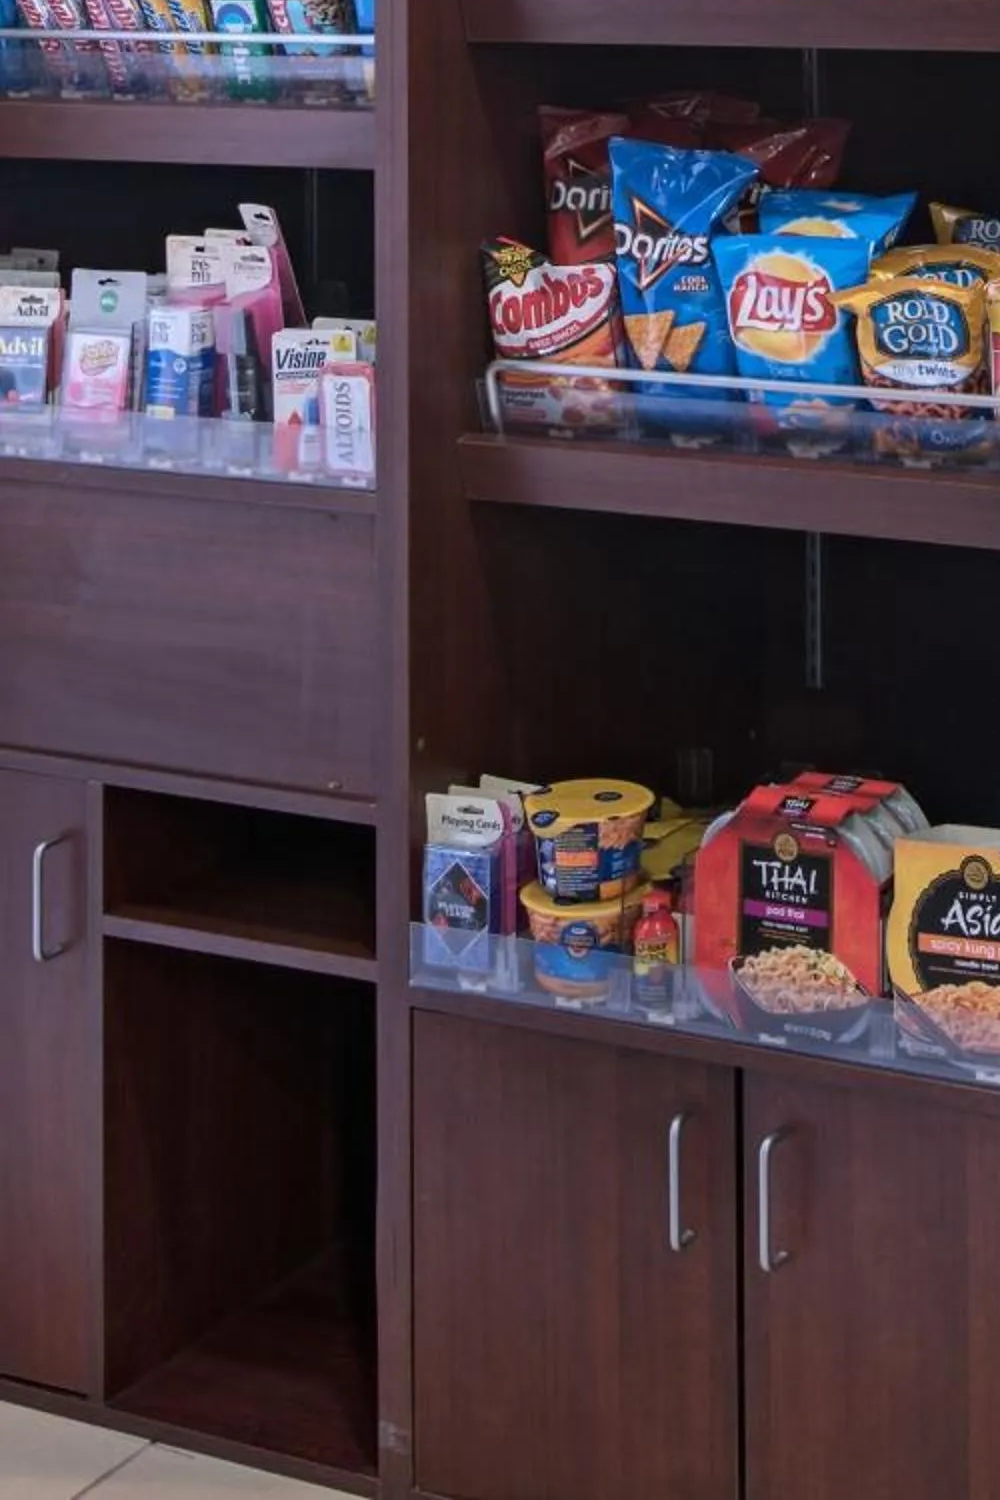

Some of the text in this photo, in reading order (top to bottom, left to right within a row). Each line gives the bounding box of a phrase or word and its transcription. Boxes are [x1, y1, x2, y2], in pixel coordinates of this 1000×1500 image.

[550, 181, 610, 211] Dori
[615, 224, 708, 263] Doritos
[17, 304, 49, 317] Advil
[489, 267, 605, 336] Combos
[734, 274, 831, 332] Lay's
[885, 299, 950, 325] ROLD
[883, 323, 959, 353] GOLD
[275, 347, 328, 369] Visine
[334, 381, 355, 467] ALTOIDS
[441, 814, 501, 831] Playing Cards
[752, 859, 818, 896] THAI
[765, 889, 809, 904] KITCHEN
[958, 891, 998, 903] SIMPLY
[765, 905, 786, 918] pad
[929, 938, 962, 953] spicy
[965, 939, 995, 959] kung
